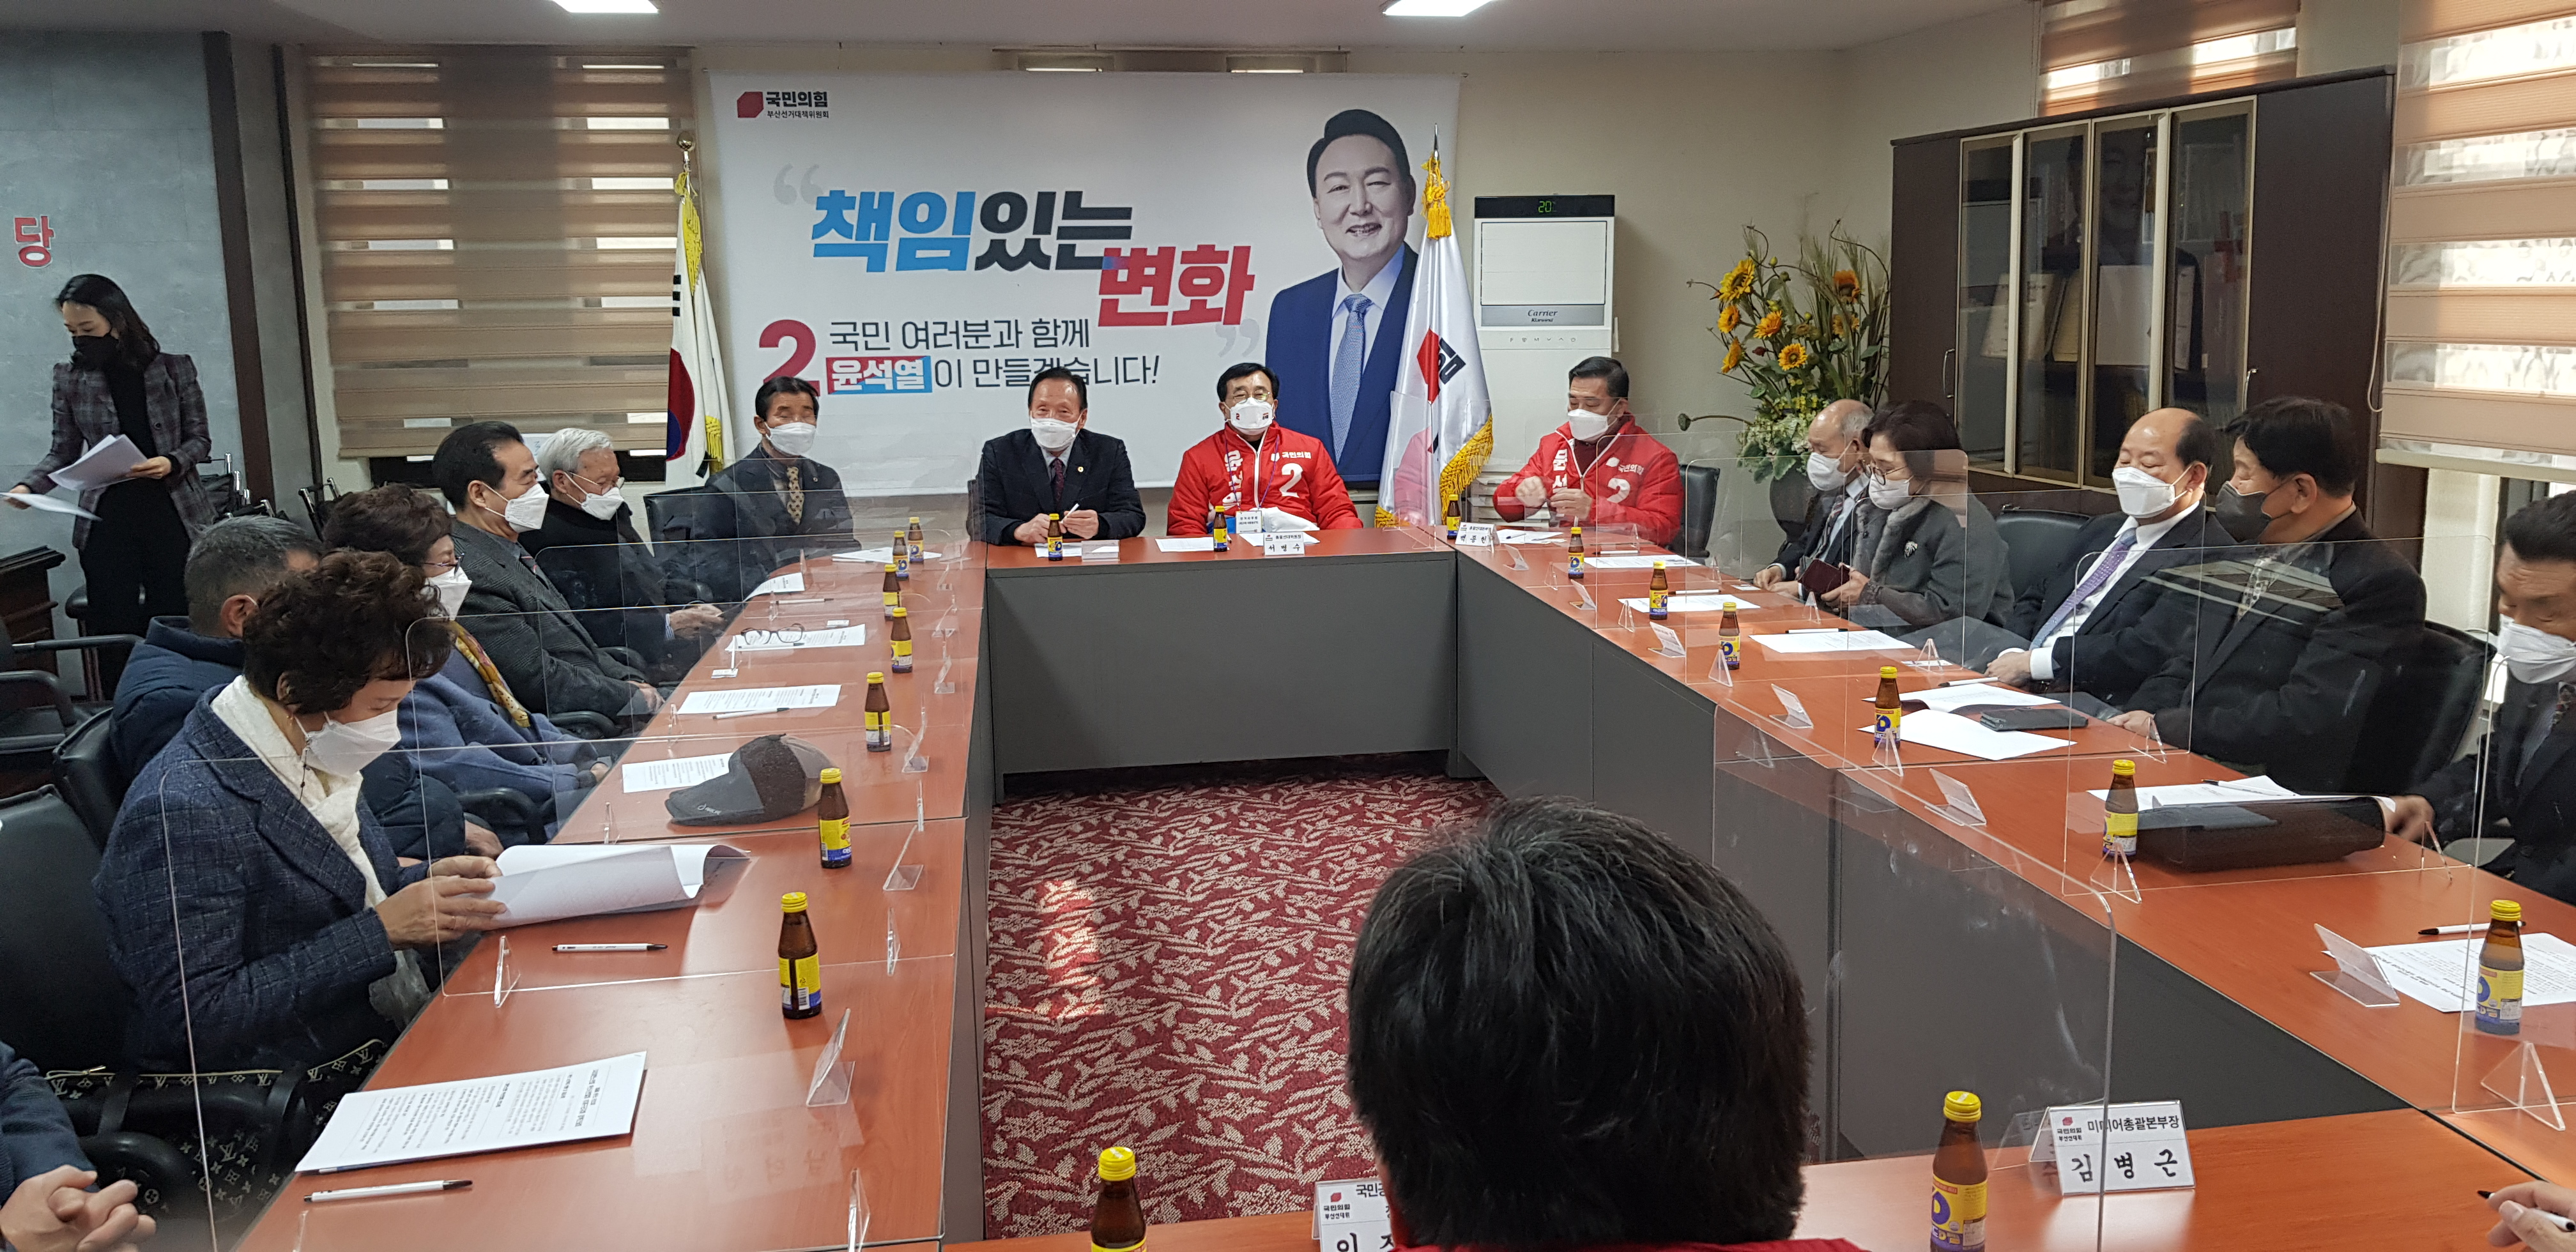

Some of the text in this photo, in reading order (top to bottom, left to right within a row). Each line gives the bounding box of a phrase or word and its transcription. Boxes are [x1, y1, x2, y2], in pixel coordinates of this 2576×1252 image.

[766, 91, 827, 107] 국민의힘
[1538, 201, 1552, 213] 20
[14, 216, 54, 267] 당
[812, 190, 1132, 273] 책임있는
[1098, 244, 1255, 326] 변화
[830, 319, 1090, 351] 국민 여러분과 함께
[759, 319, 820, 396] 2
[1279, 463, 1303, 498] 2
[2087, 1115, 2180, 1134] 미디어총괄본부장
[1324, 1203, 1351, 1212] 국민의힘
[1325, 1212, 1349, 1220] 부산선대위
